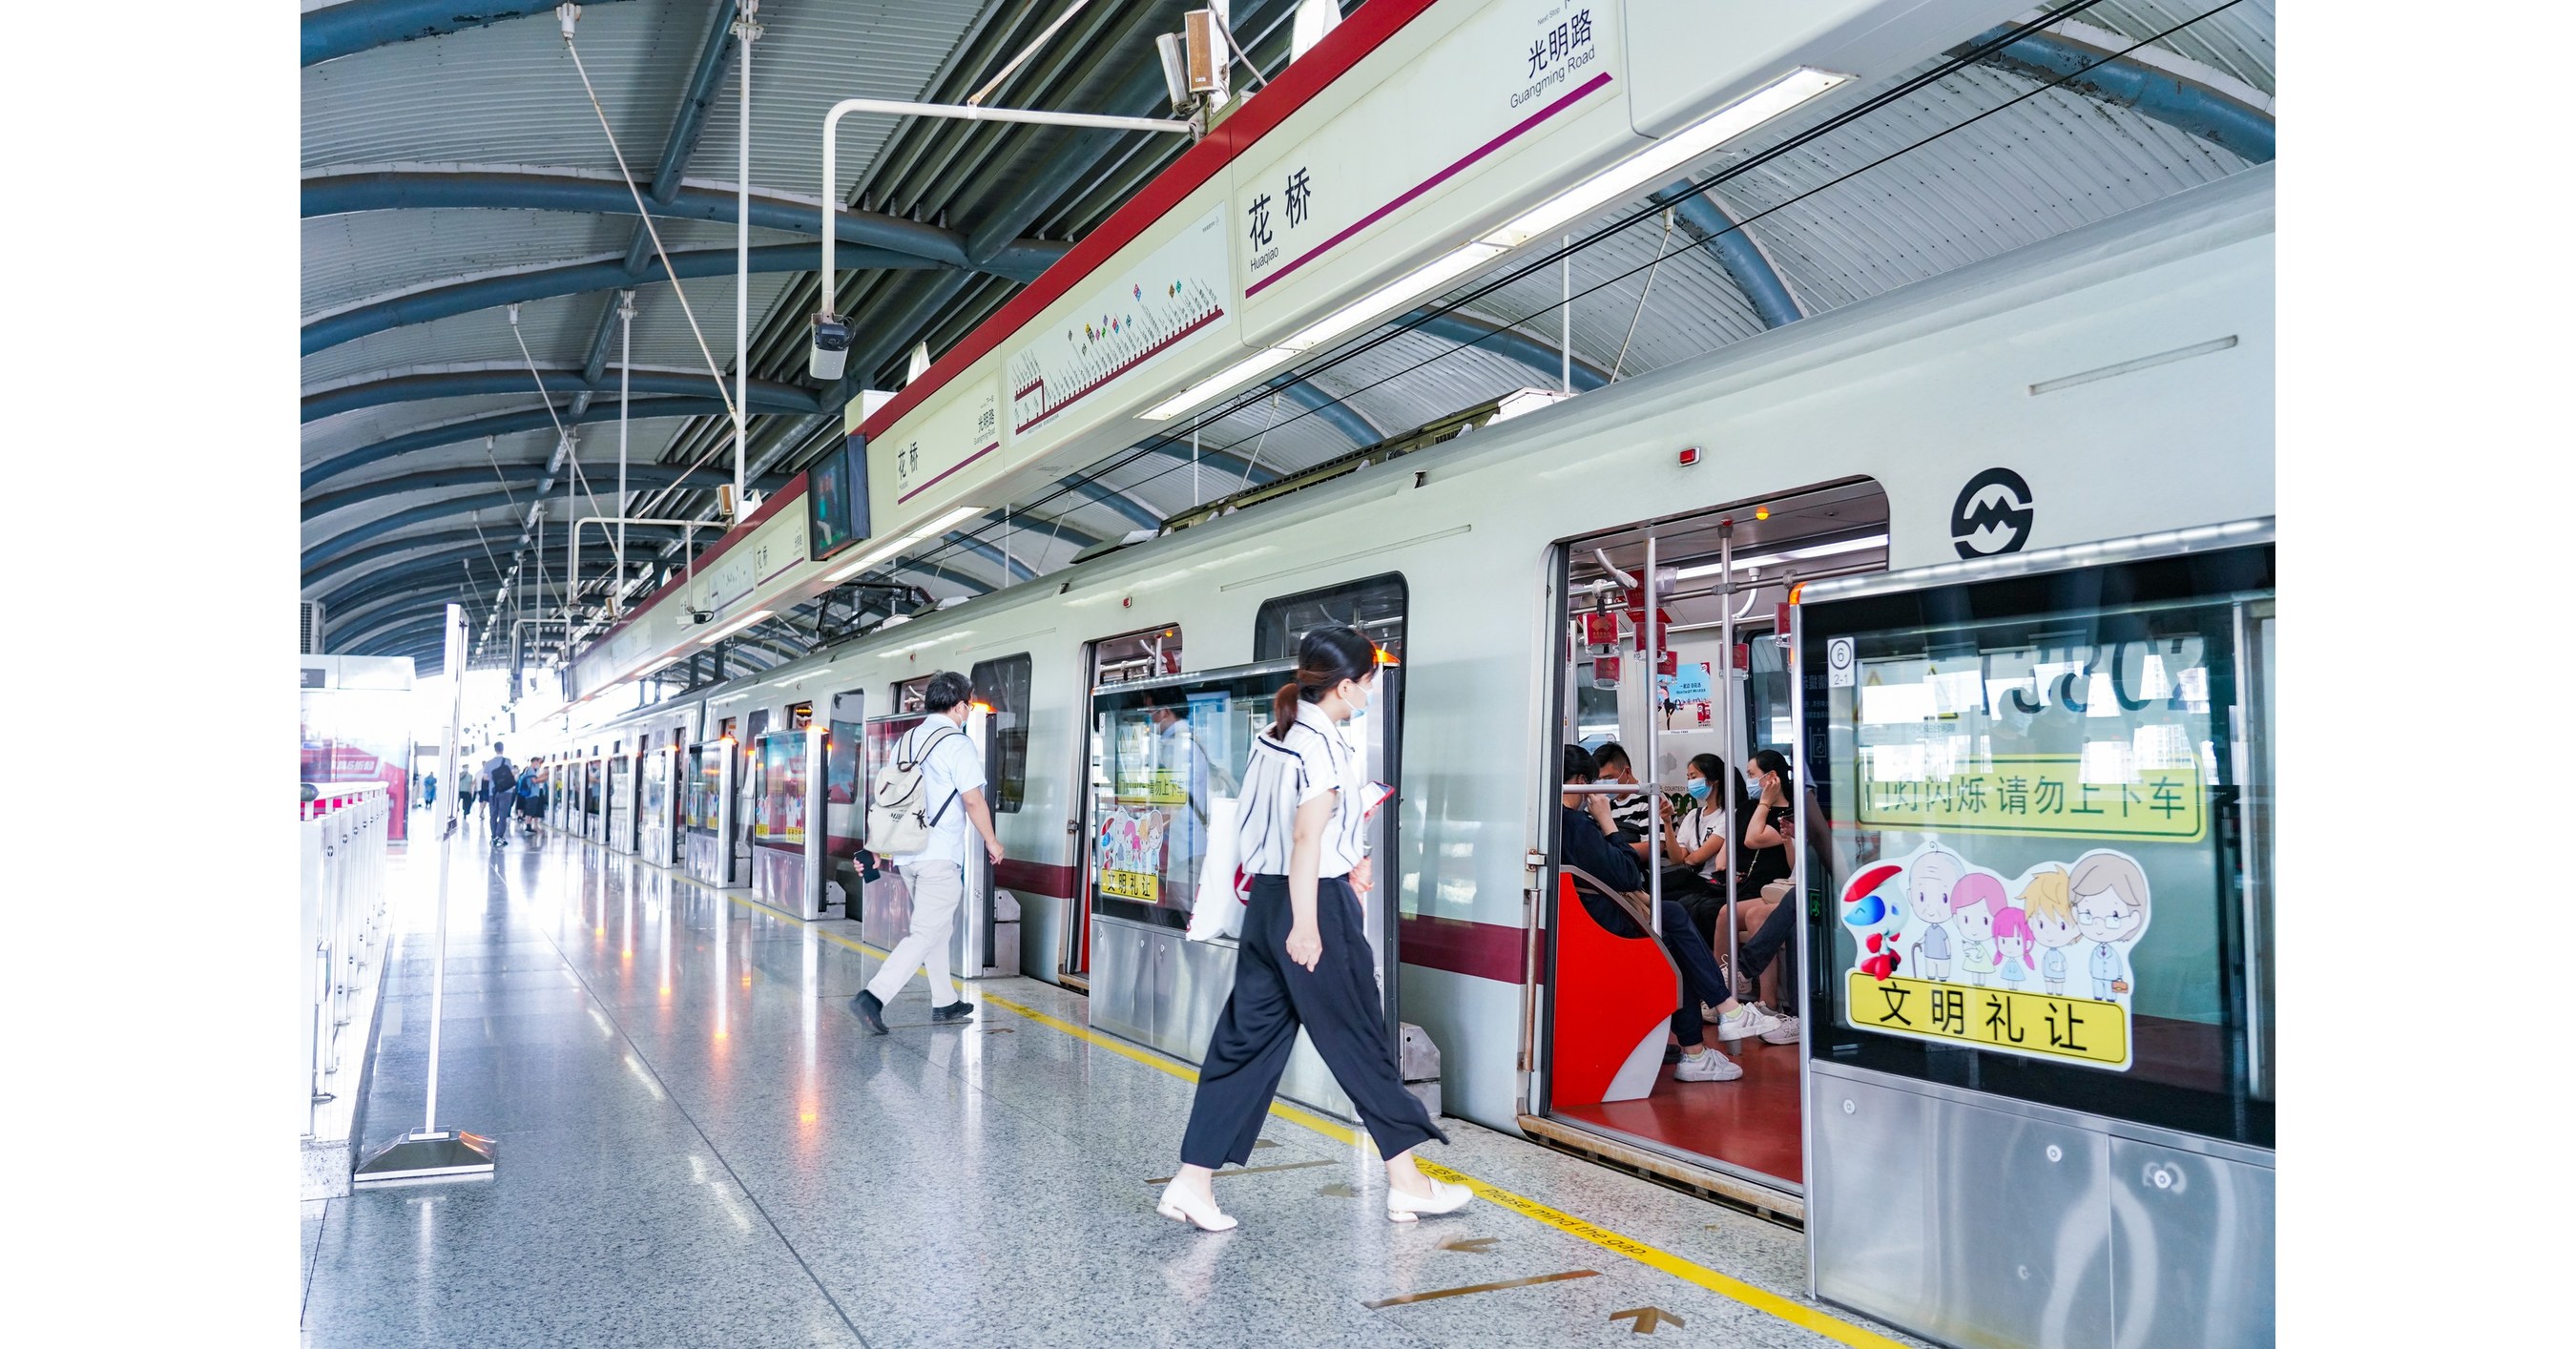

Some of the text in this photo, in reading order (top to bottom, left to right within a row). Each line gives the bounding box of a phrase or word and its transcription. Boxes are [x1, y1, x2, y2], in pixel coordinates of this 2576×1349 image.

[1537, 7, 1561, 27] Next Stop
[1527, 9, 1592, 79] 光明路
[1510, 44, 1595, 109] Guangming Road
[1248, 166, 1311, 253] 花桥
[1250, 247, 1279, 272] Huaqiao
[898, 441, 918, 481] 花桥
[1837, 648, 1845, 663] 6
[1834, 674, 1849, 686] 2-1
[1107, 873, 1151, 898] 文明礼让
[1878, 981, 2088, 1051] 文明礼让
[1480, 1188, 1648, 1256] Please mind the gap.
